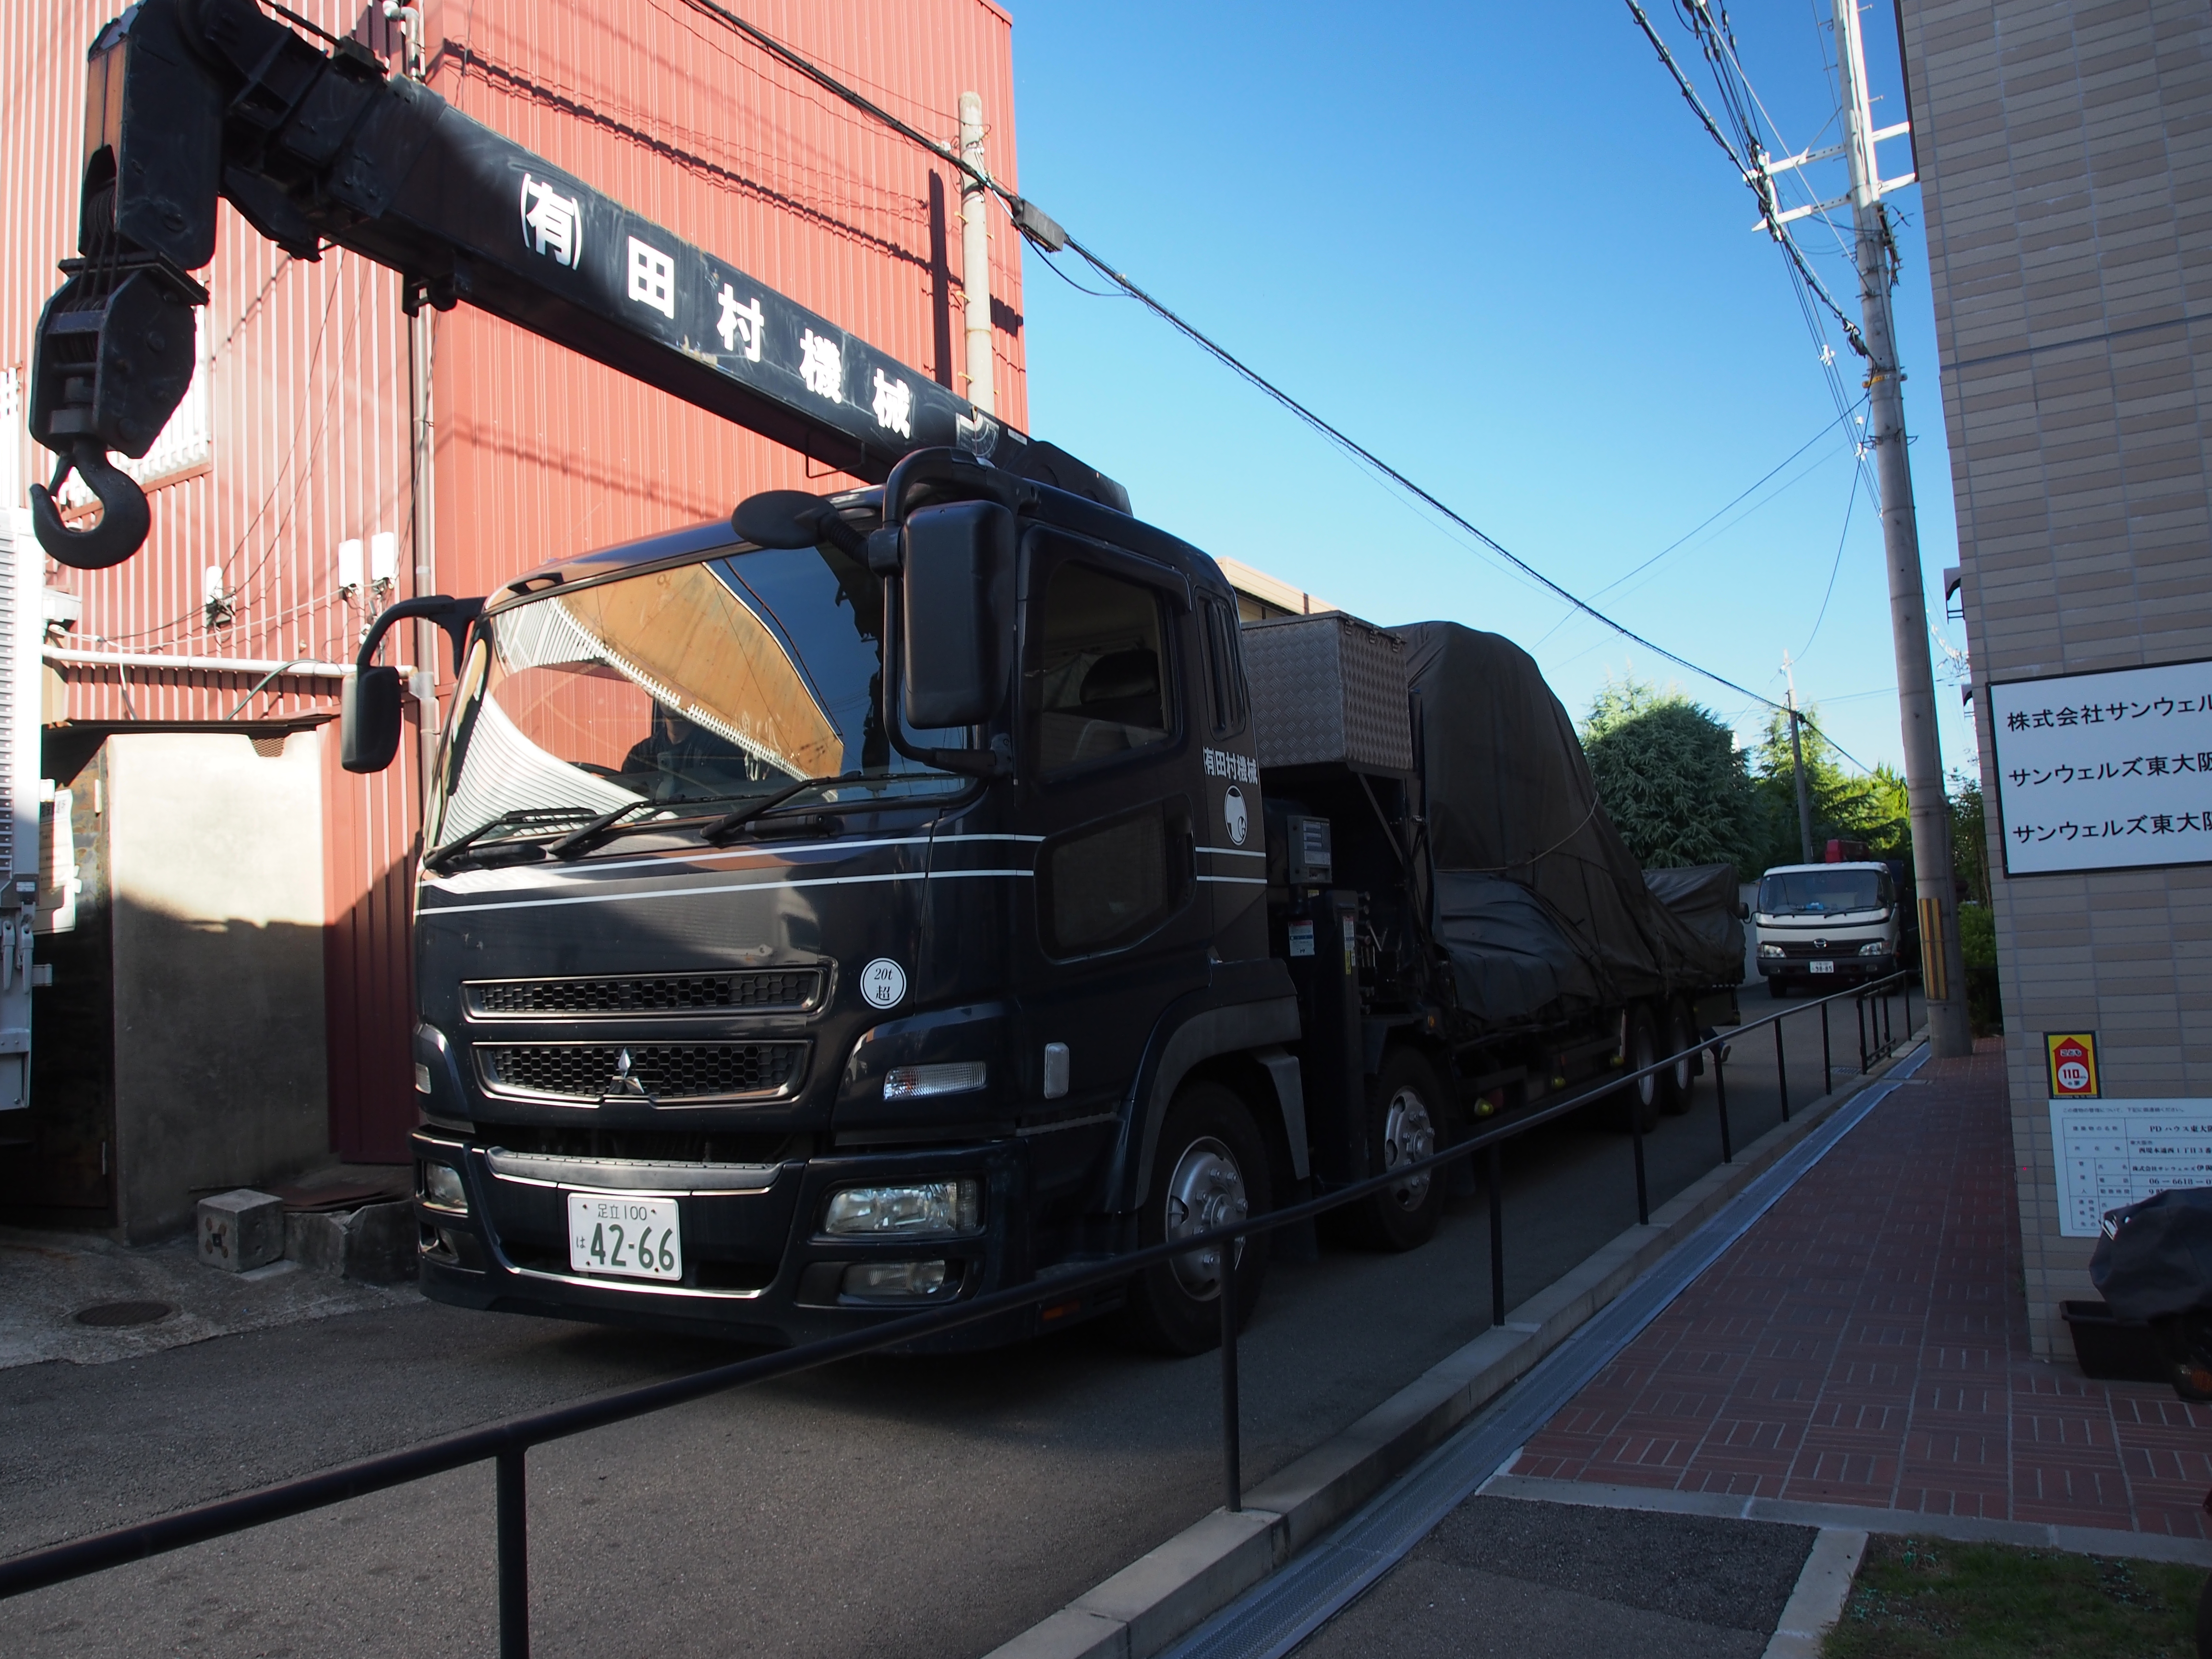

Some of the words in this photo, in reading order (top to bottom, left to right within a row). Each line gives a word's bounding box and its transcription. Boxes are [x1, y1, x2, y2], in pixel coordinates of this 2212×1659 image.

[2007, 694, 2212, 732] 株式会社サンウェル
[874, 968, 892, 980] 20t
[876, 985, 890, 1001] 超
[590, 1222, 675, 1271] 42-66
